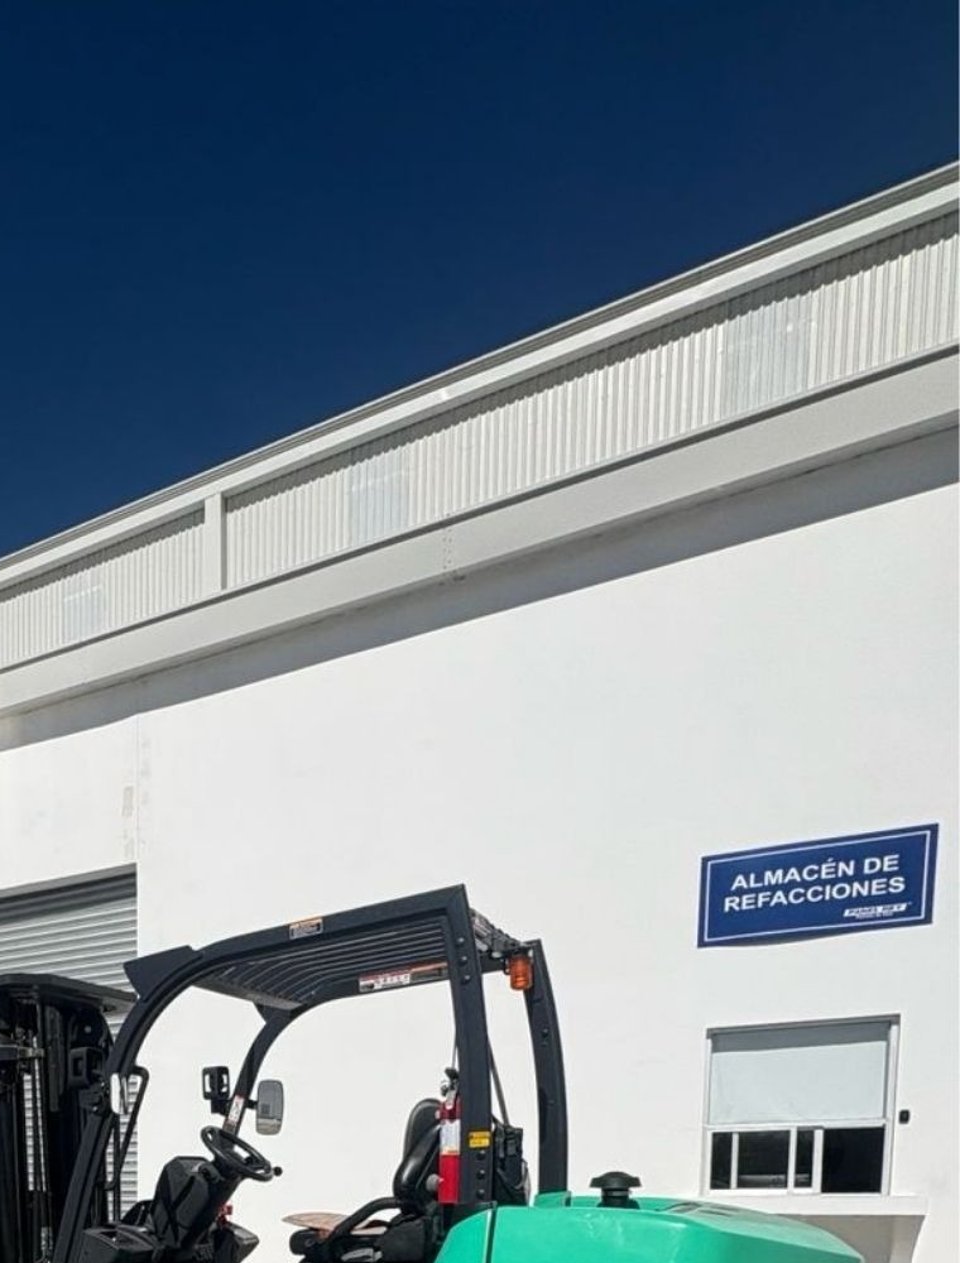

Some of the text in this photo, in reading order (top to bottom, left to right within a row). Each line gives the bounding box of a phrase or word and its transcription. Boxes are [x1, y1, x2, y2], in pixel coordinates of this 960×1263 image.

[730, 854, 900, 891] ALMACÉN DE
[723, 876, 906, 913] REFACCIONES
